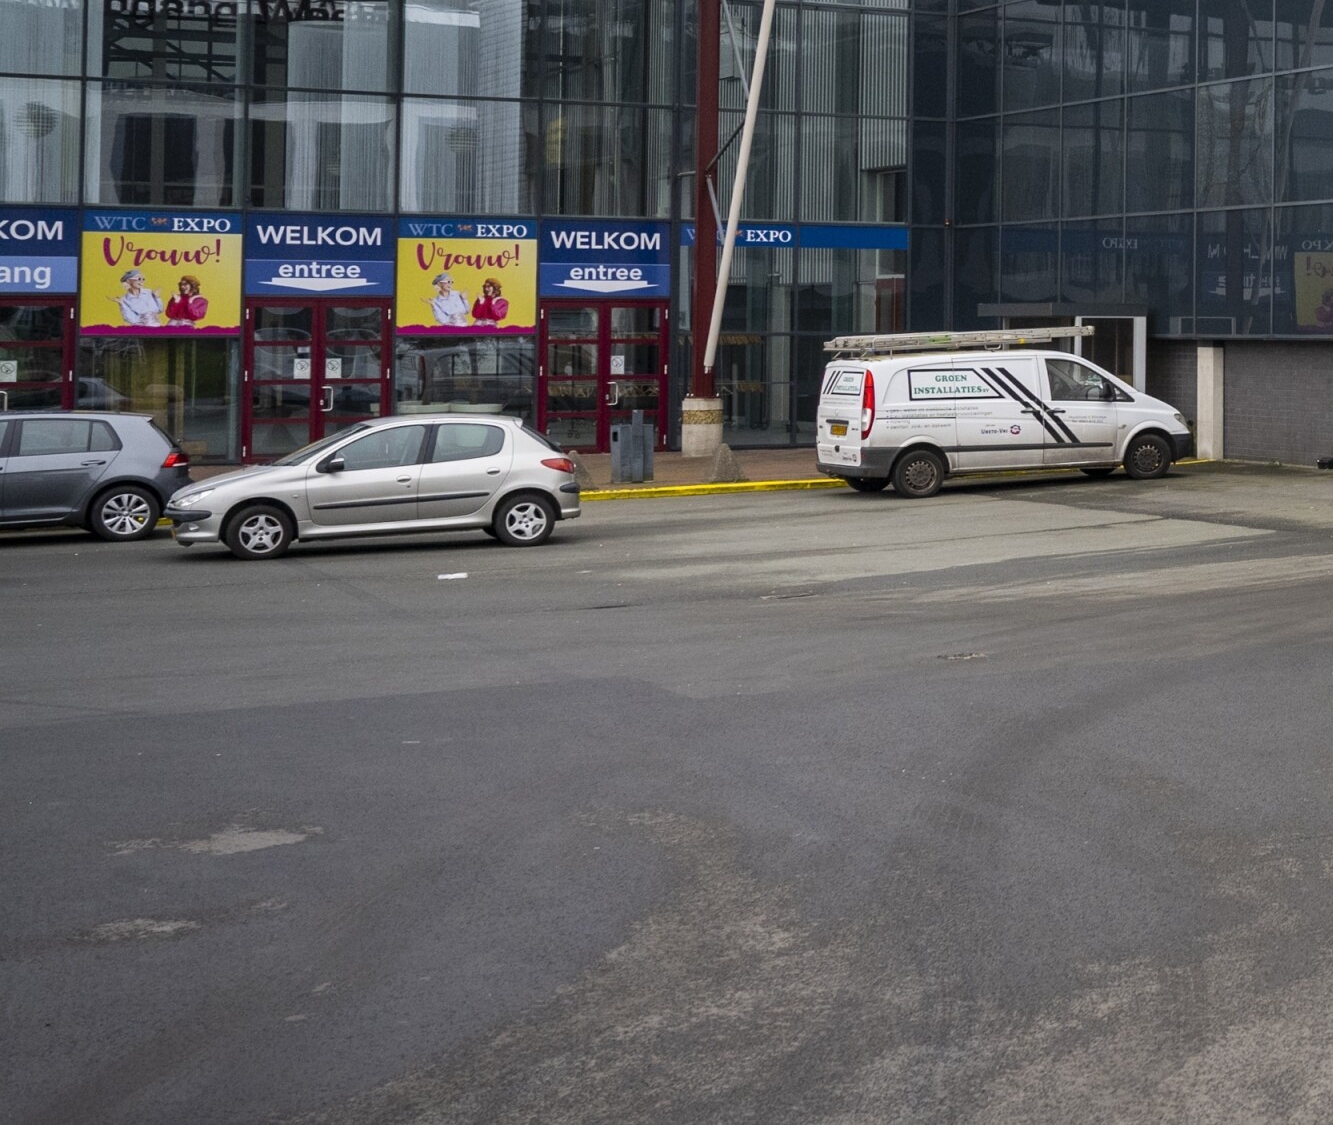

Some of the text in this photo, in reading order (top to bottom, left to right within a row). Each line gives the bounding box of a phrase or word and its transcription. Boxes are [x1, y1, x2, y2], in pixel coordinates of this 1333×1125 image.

[94, 216, 231, 232] WTC EXPO
[408, 223, 528, 238] WTC EXPO
[256, 225, 382, 246] WELKOM
[550, 231, 661, 250] WELKOM
[745, 229, 792, 243] EXPO
[103, 236, 222, 267] Vrouw!
[416, 241, 520, 270] Vrouw!
[278, 261, 361, 278] entree
[569, 265, 643, 280] entree
[935, 374, 967, 383] GROEN
[913, 385, 982, 395] INSTALLATIES
